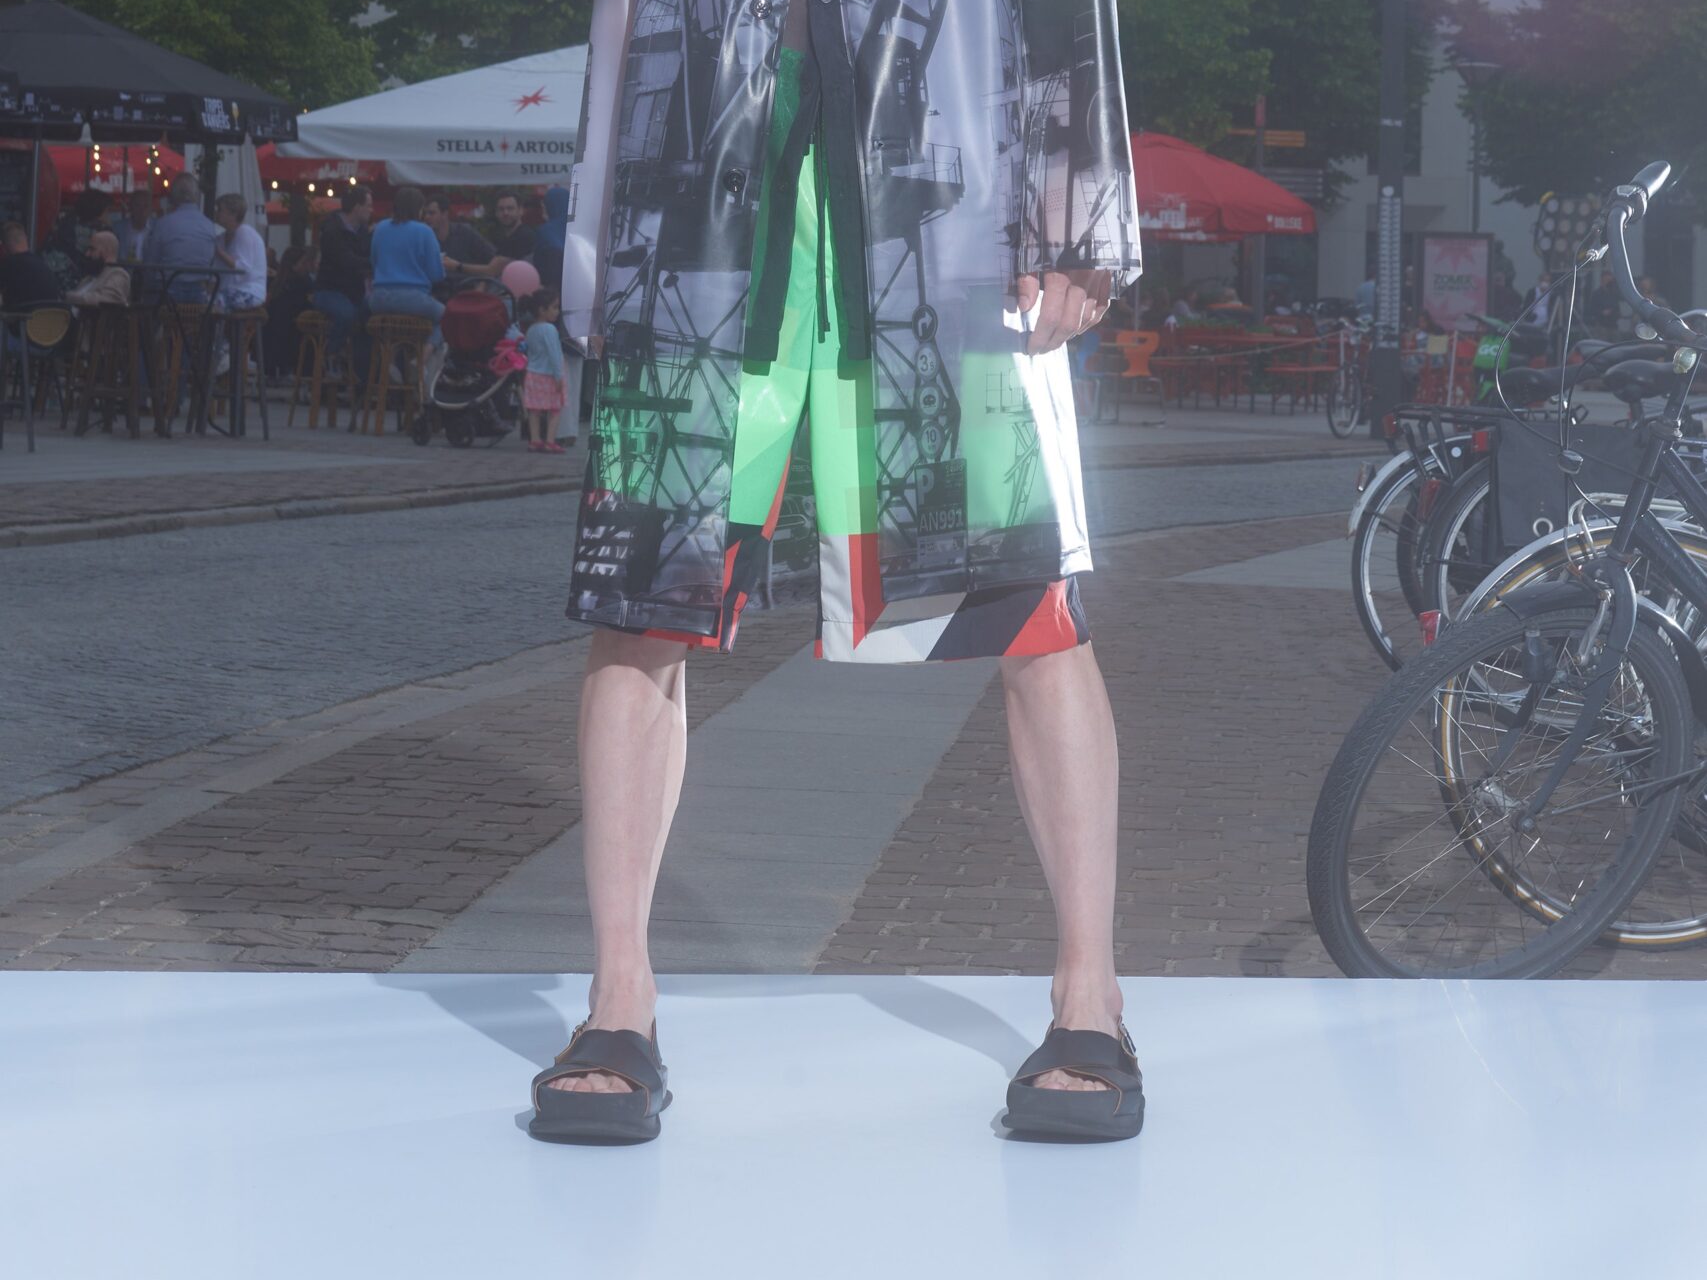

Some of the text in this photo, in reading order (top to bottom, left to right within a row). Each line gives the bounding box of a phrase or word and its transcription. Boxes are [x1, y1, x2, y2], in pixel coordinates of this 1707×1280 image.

[437, 139, 574, 154] STELLA ARTOIS
[521, 163, 569, 175] STELLA
[925, 429, 937, 443] 10
[916, 468, 935, 506] P
[919, 508, 964, 533] AN991
